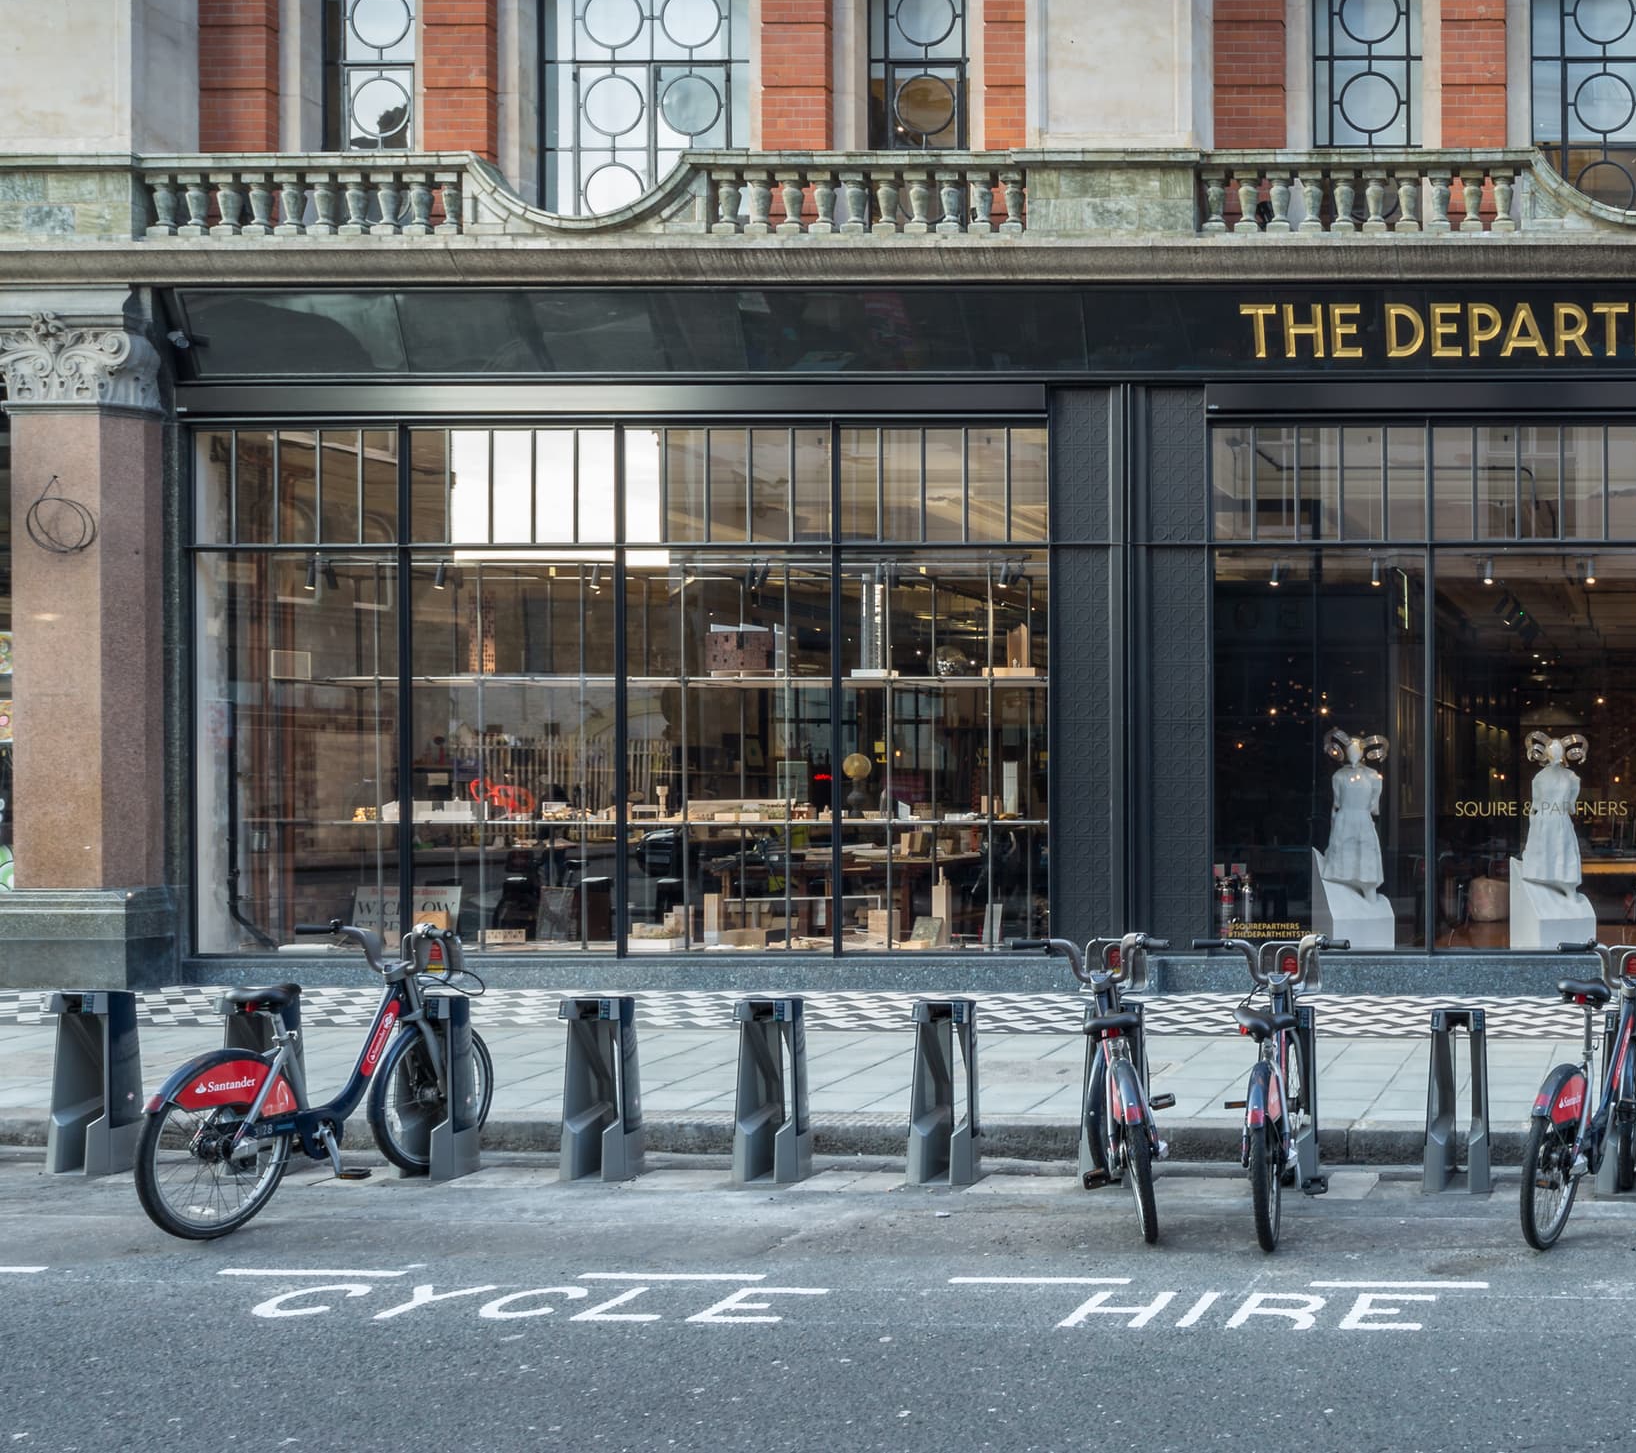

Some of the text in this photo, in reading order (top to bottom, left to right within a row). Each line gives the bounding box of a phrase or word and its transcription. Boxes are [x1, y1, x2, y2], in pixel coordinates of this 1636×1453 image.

[1240, 302, 1363, 358] THE
[1455, 800, 1518, 818] SQUIRE
[207, 1076, 257, 1093] Santander
[251, 1284, 830, 1323] CYCLE
[1054, 1291, 1437, 1331] HIRE
